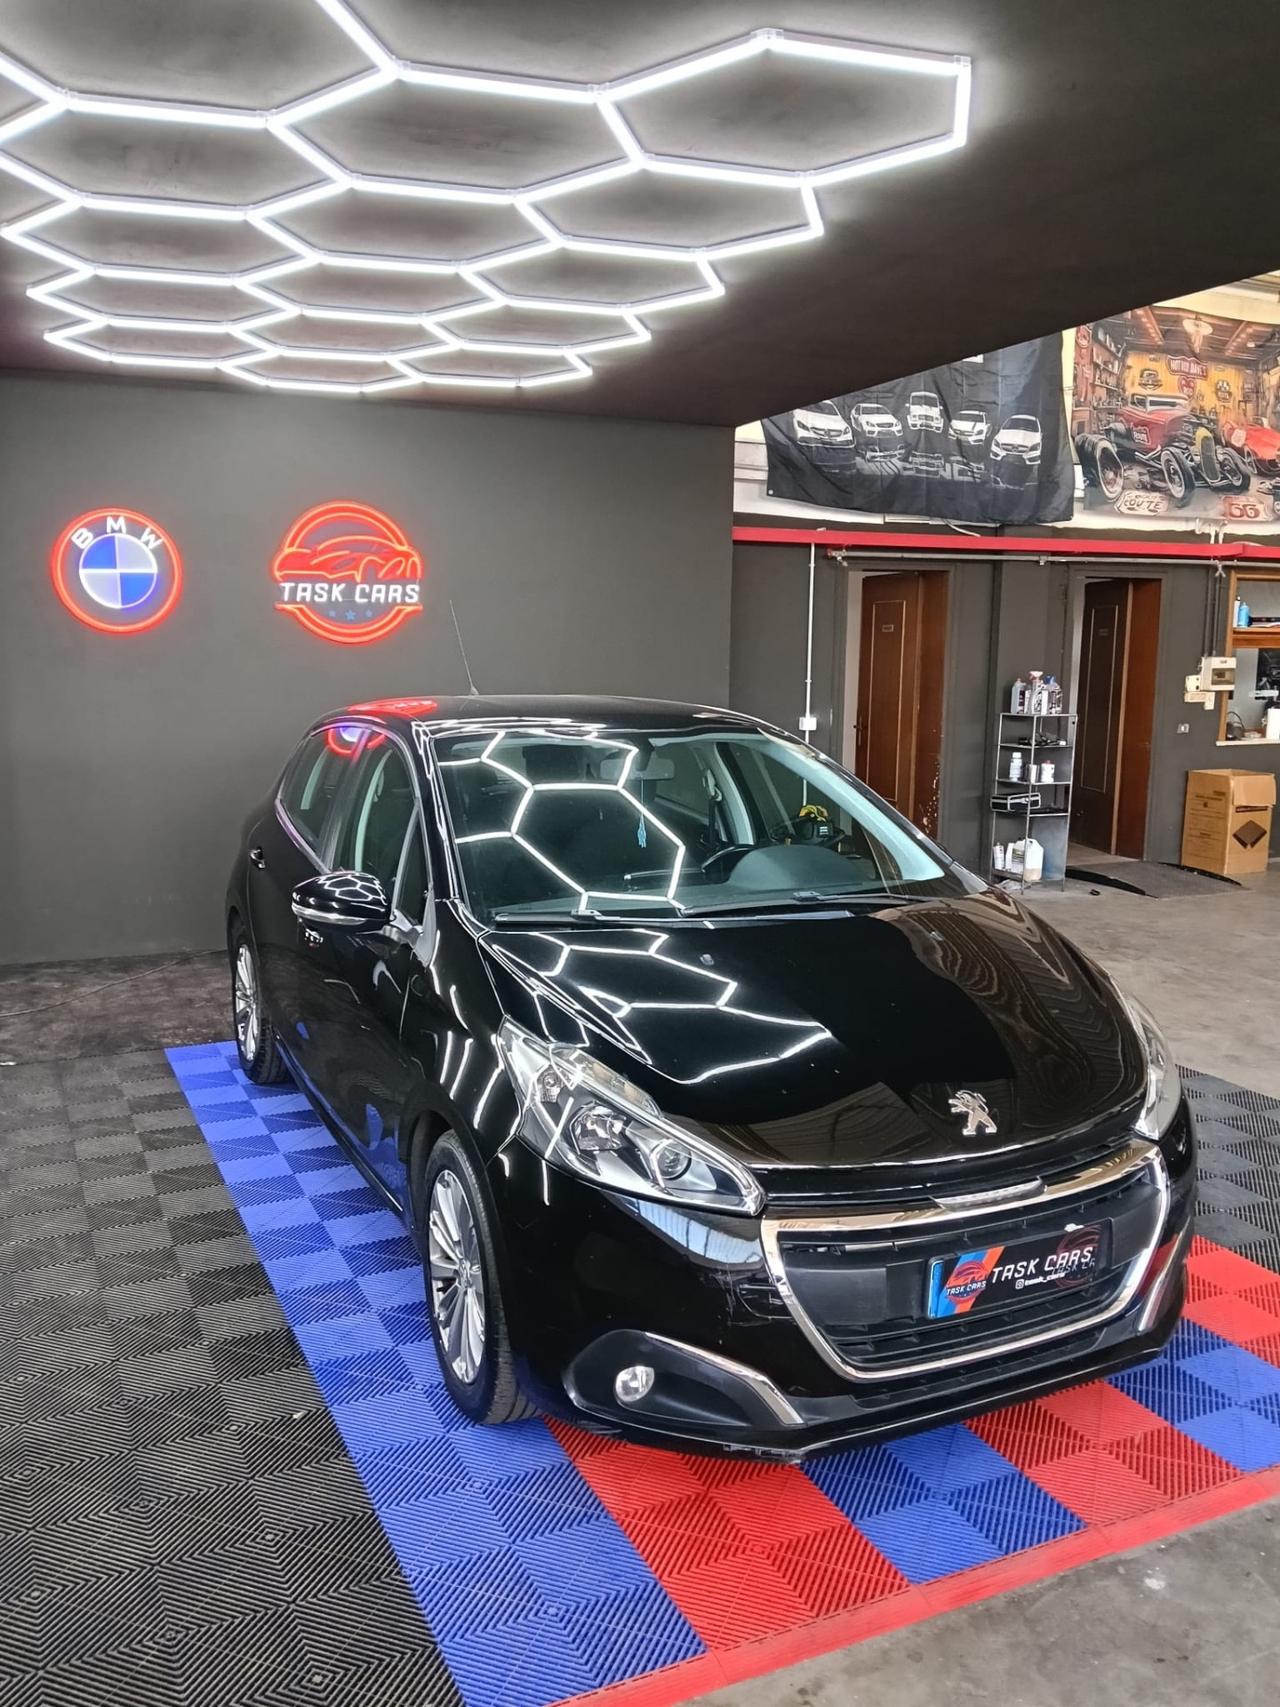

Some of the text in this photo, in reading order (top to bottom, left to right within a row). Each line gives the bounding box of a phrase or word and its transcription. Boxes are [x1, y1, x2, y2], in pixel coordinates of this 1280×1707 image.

[70, 515, 163, 551] BMW
[279, 581, 421, 604] TASK CARS
[991, 1246, 1093, 1284] TASK CARS
[946, 1280, 987, 1296] TASK CARS
